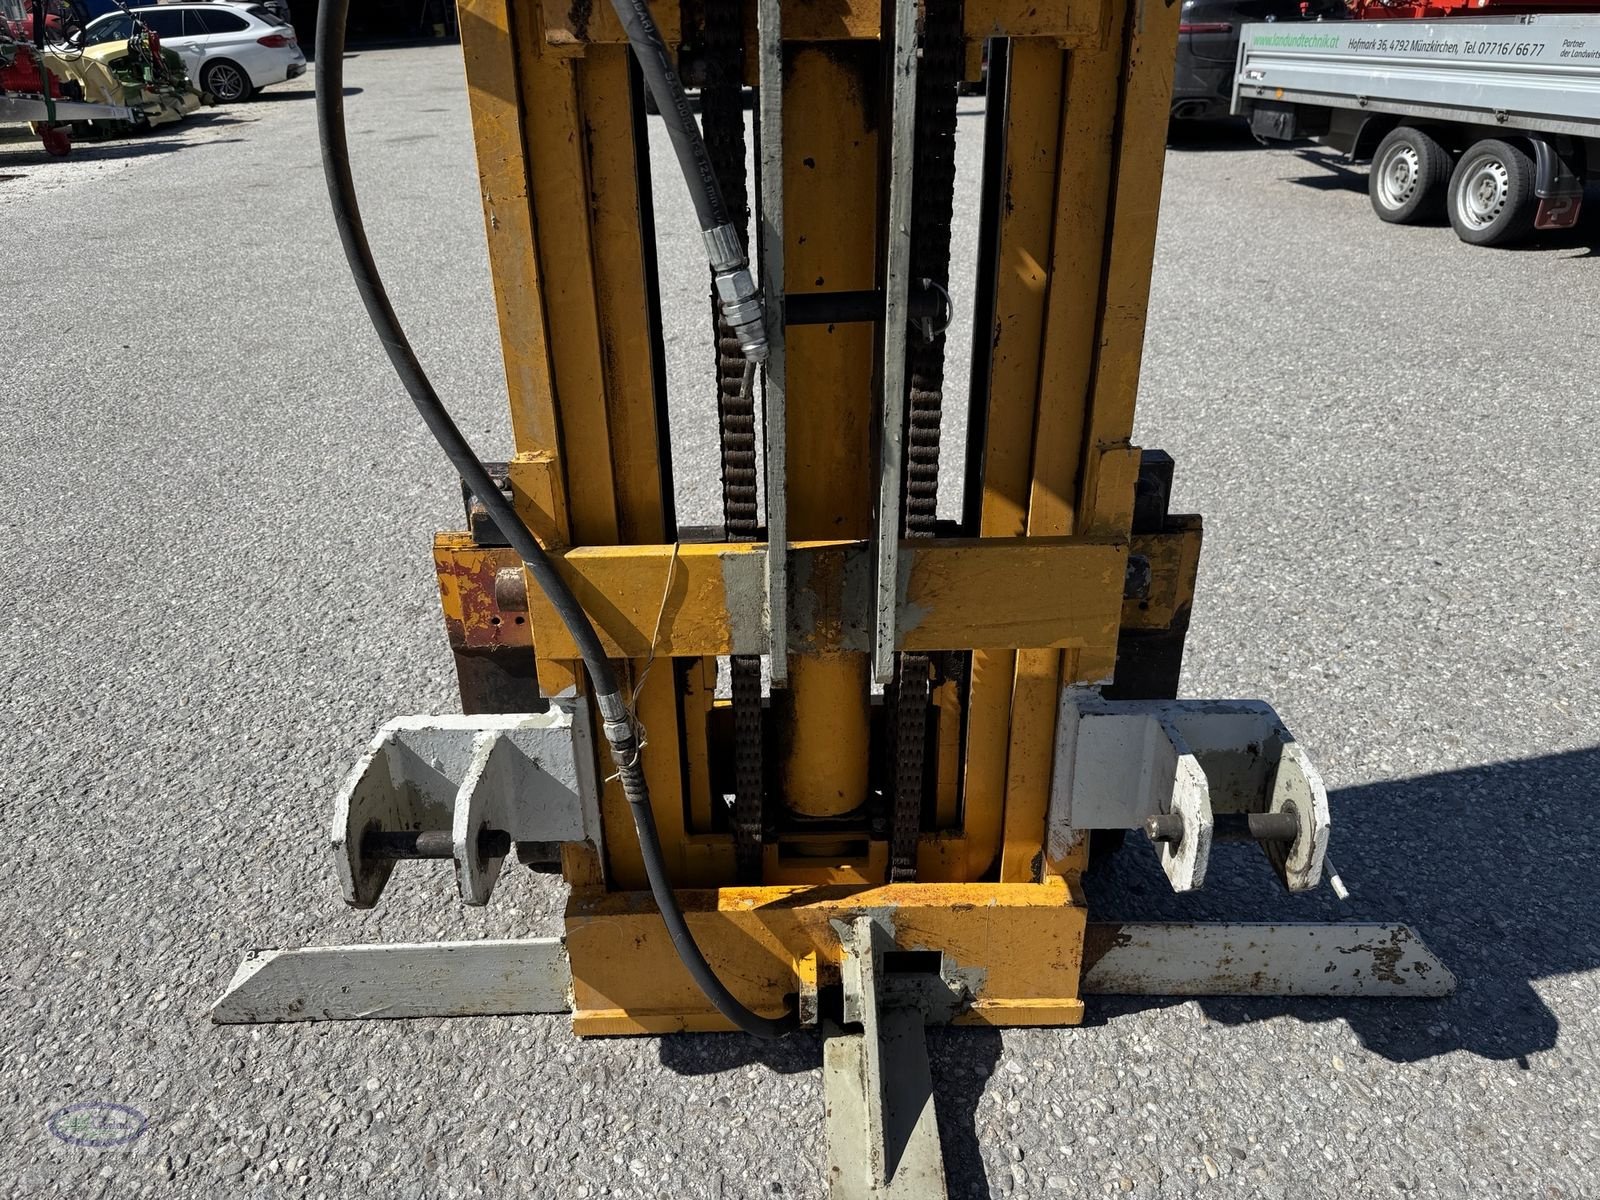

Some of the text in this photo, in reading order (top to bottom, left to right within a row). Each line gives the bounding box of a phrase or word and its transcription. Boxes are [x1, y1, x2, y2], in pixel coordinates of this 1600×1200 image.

[1253, 33, 1340, 49] www.landundtechnik.at
[1348, 39, 1376, 53] Hofmark
[1377, 40, 1388, 52] 36,
[1389, 40, 1409, 51] 4792
[1410, 40, 1458, 55] Münzkirchen,
[1463, 41, 1476, 54] Tel.
[1562, 39, 1586, 48] Partner
[1560, 50, 1570, 58] der
